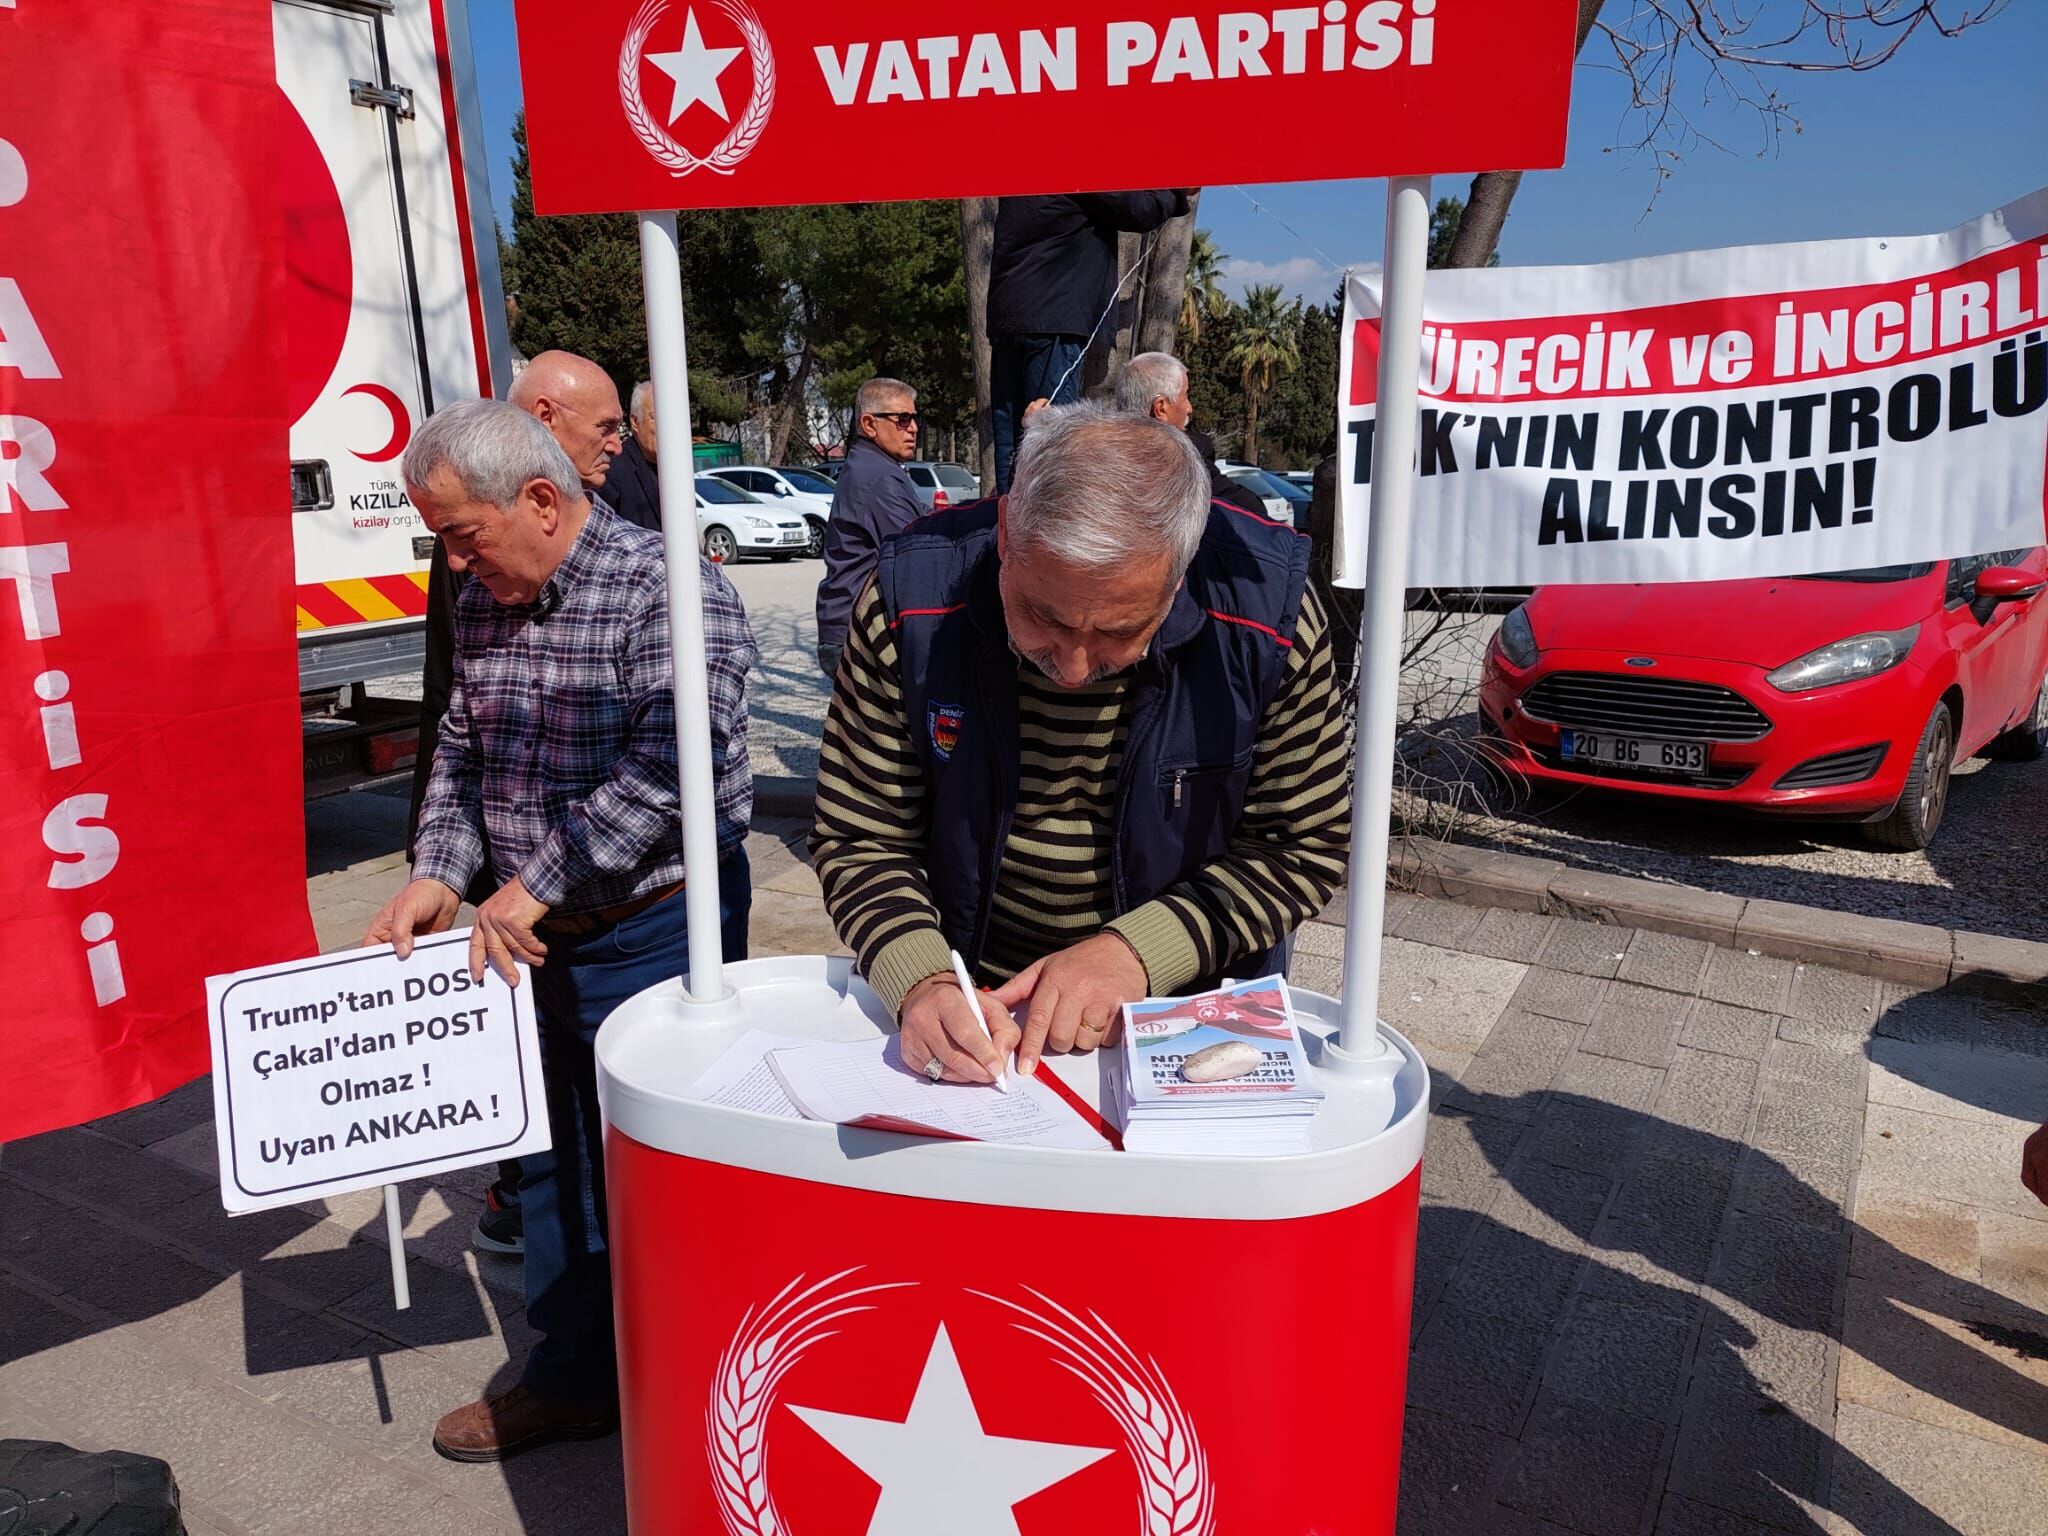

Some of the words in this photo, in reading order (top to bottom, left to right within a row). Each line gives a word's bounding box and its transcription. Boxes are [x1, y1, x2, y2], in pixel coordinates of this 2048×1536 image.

[812, 26, 1078, 105] VATAN
[1669, 329, 1754, 386] ve
[1348, 407, 1601, 485] TK'NIN
[350, 492, 411, 511] KIZILA
[369, 480, 398, 491] TÜRK
[1537, 457, 1876, 547] ALINSIN!
[1575, 734, 1599, 757] 20
[1615, 738, 1640, 762] BG
[1661, 744, 1702, 768] 693
[242, 987, 394, 1033] Trump'tan
[252, 1032, 396, 1080] Çakal'dan
[405, 1008, 489, 1046] POST
[320, 1072, 414, 1106] Olmaz
[422, 1063, 432, 1086] !
[260, 1132, 336, 1166] Uyan
[345, 1099, 483, 1148] ANKARA
[490, 1094, 500, 1118] !
